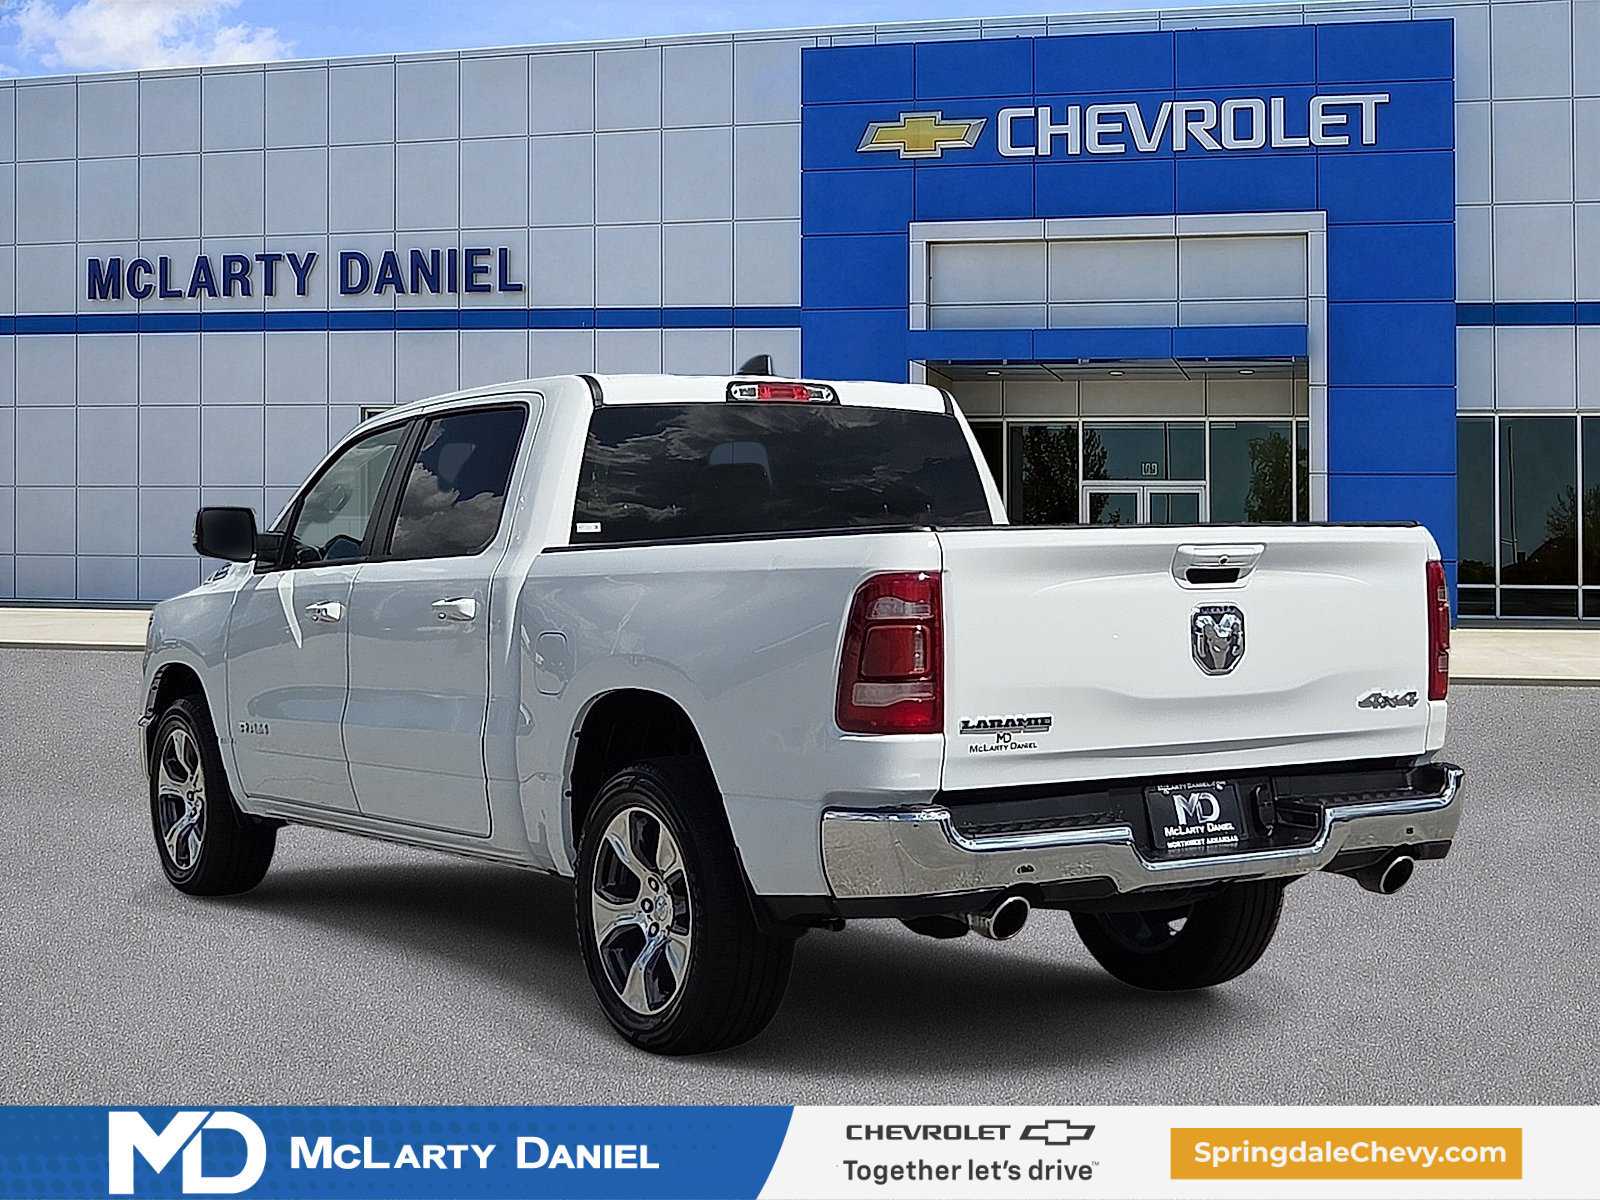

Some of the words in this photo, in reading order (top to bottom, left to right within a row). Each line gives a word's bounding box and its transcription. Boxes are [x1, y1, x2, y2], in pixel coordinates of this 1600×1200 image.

[997, 94, 1389, 157] CHEVROLET
[338, 246, 526, 297] DANIEL
[961, 715, 1052, 730] LARAMIE
[996, 732, 1012, 744] MD
[1172, 792, 1220, 825] MD
